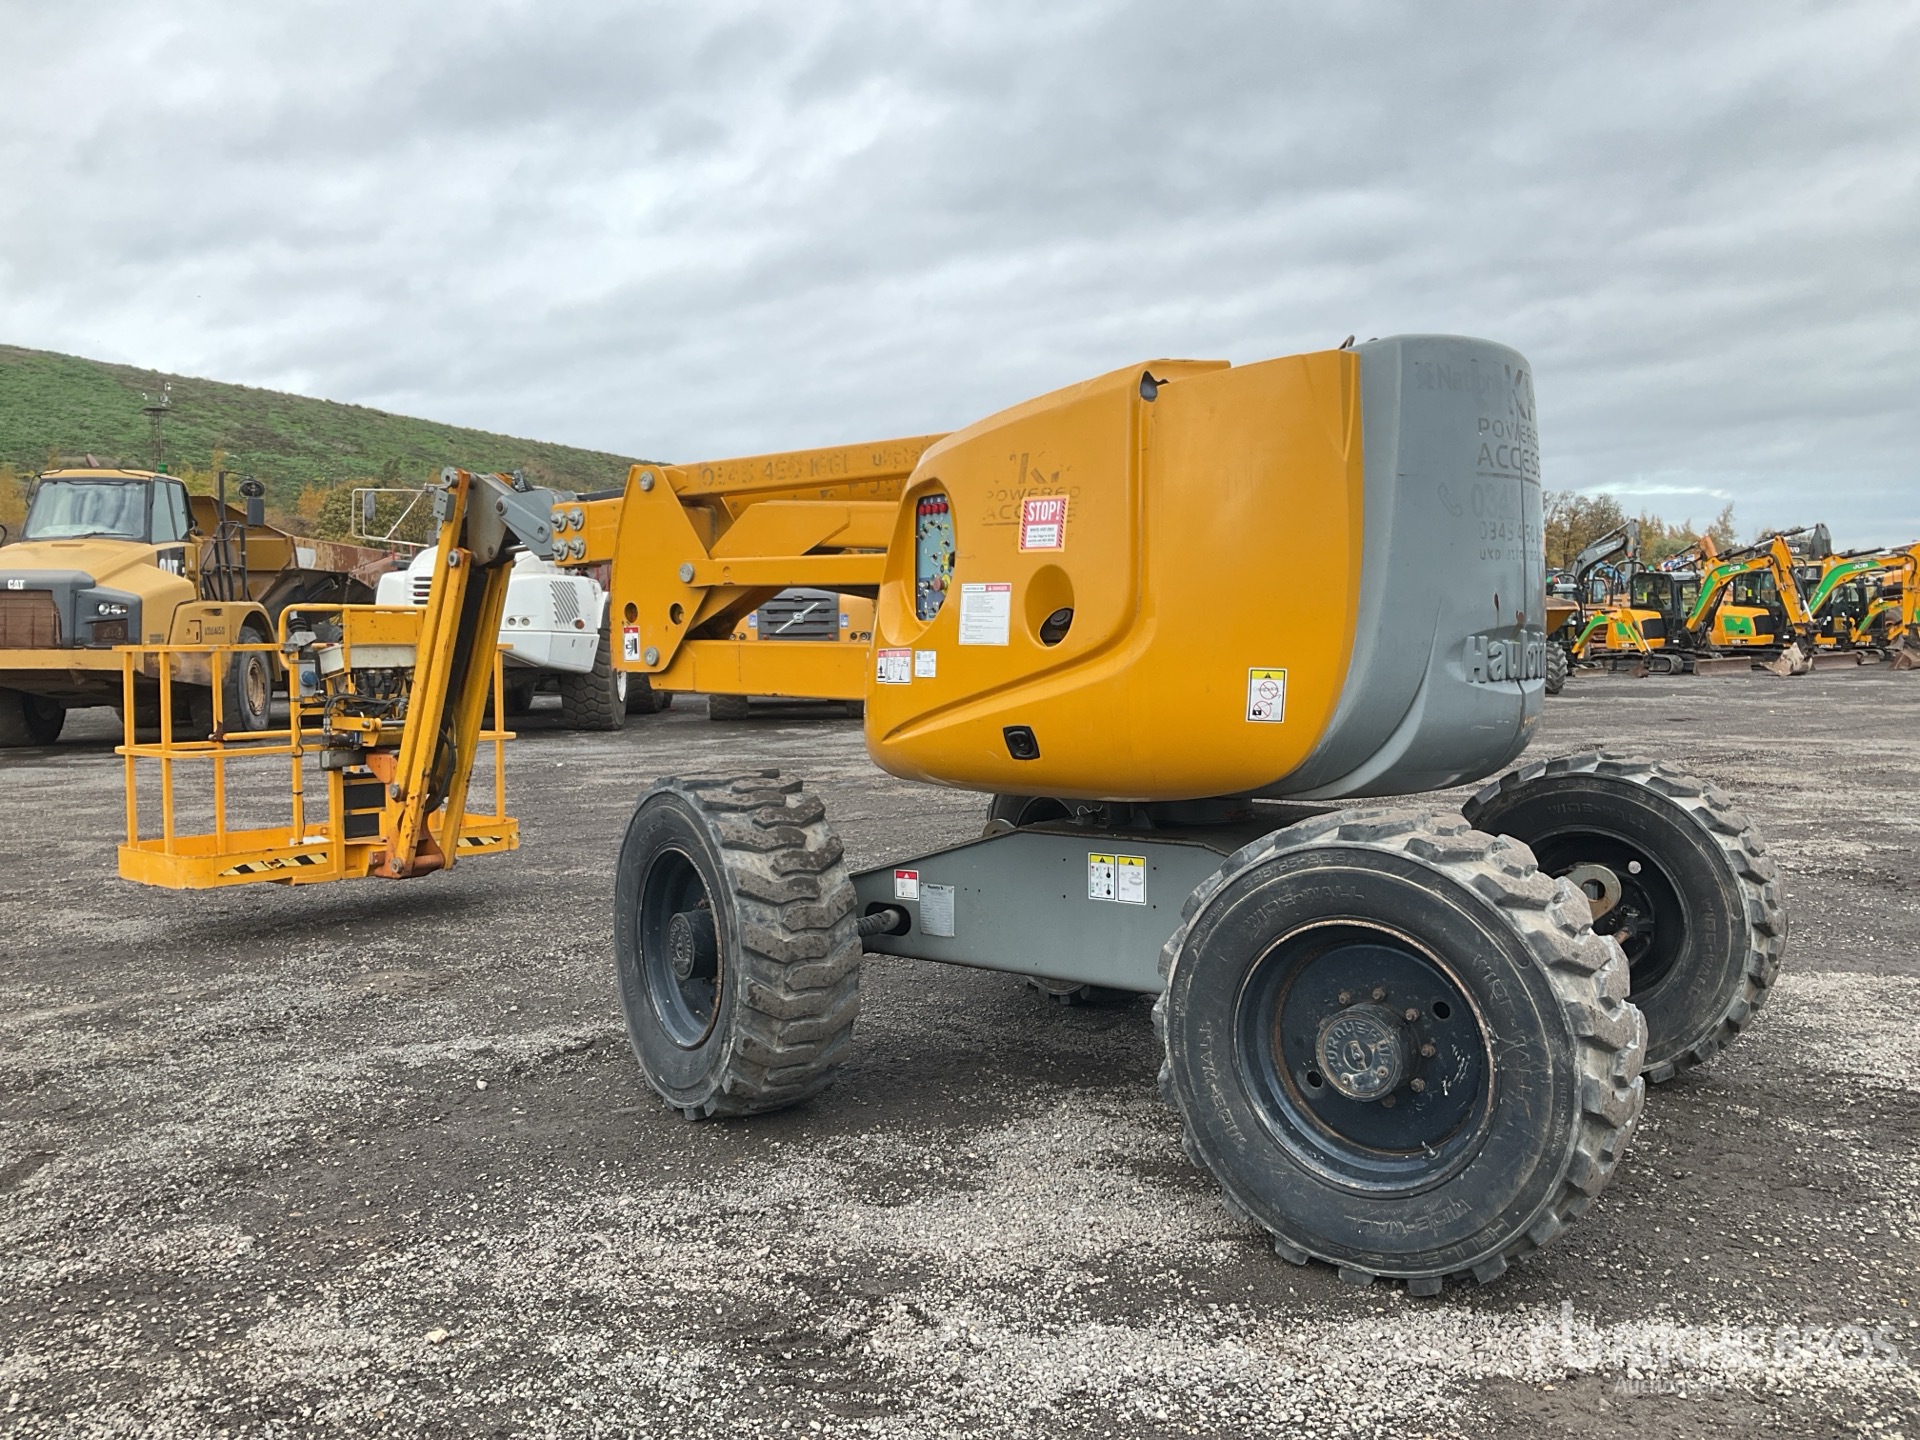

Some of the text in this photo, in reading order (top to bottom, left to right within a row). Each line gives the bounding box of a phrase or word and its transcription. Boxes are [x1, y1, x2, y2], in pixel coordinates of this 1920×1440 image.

[1028, 500, 1060, 522] STOP!
[1852, 562, 1869, 570] JCB
[7, 579, 25, 590] CAT
